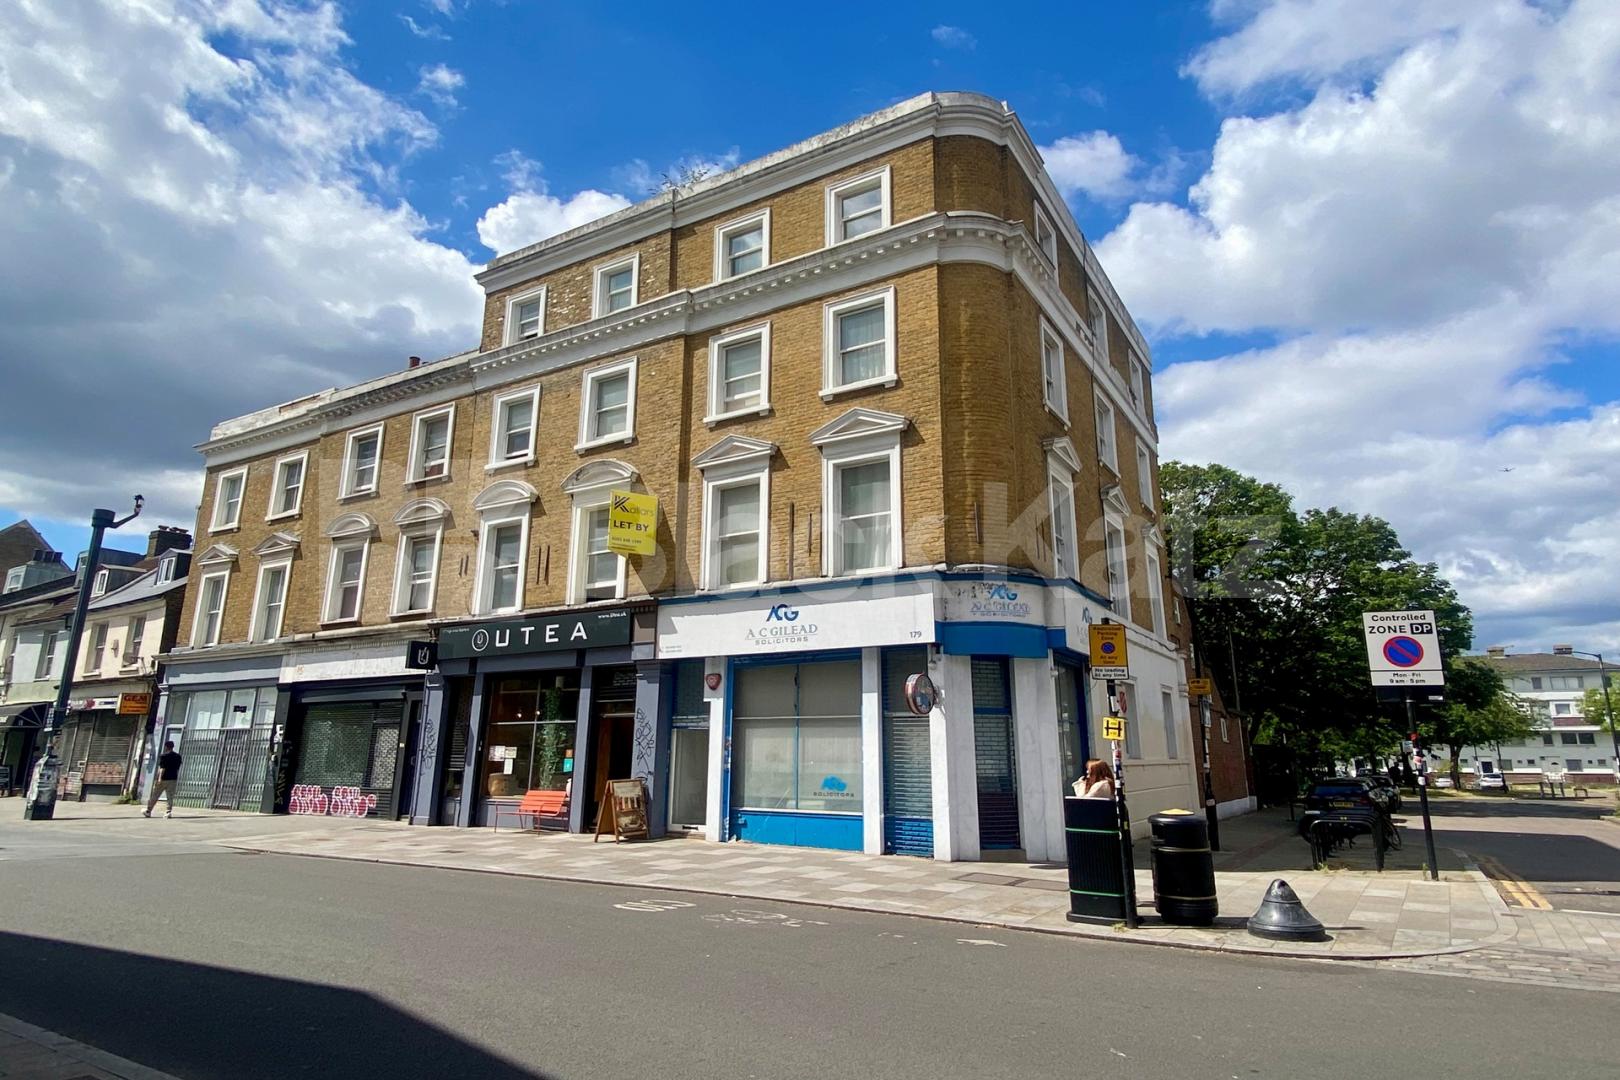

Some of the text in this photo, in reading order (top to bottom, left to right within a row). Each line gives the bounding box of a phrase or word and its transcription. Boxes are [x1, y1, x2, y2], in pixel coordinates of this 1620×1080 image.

[613, 520, 649, 532] LET BY
[1371, 613, 1426, 622] Controlled
[745, 623, 818, 639] A C GILEAD
[1368, 624, 1431, 634] ZONE DP
[495, 621, 588, 648] UTEA
[909, 630, 922, 639] 179
[754, 636, 809, 646] SOLICITORS
